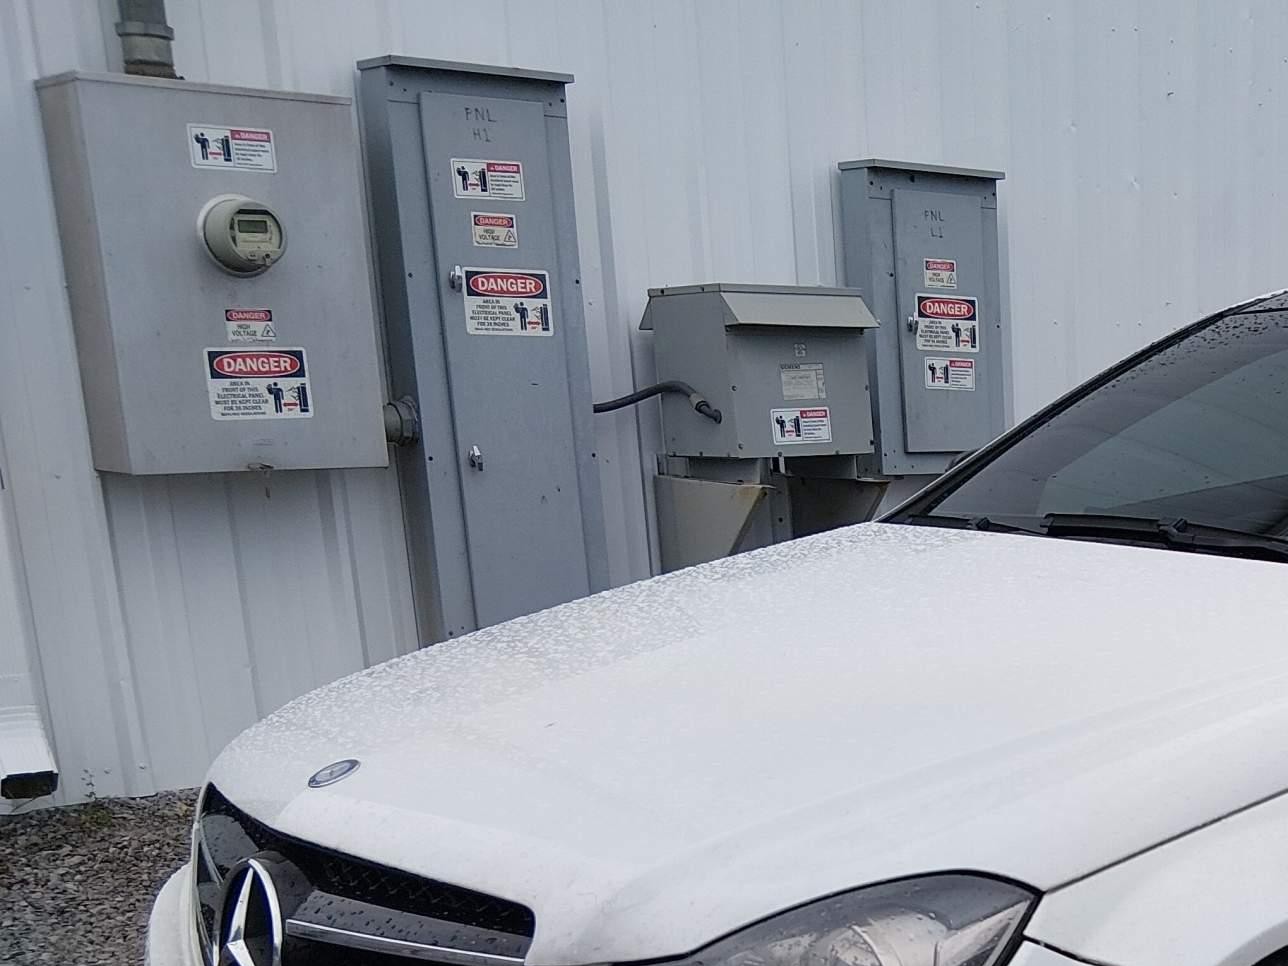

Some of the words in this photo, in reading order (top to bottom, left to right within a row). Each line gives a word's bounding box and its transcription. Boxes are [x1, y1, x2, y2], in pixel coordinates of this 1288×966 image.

[464, 107, 497, 122] PNL
[479, 217, 509, 226] DANGER
[924, 209, 945, 222] PNL
[477, 277, 537, 292] DANGER
[231, 311, 266, 320] DANGER
[926, 302, 969, 316] DANGER
[222, 357, 292, 372] DANGER
